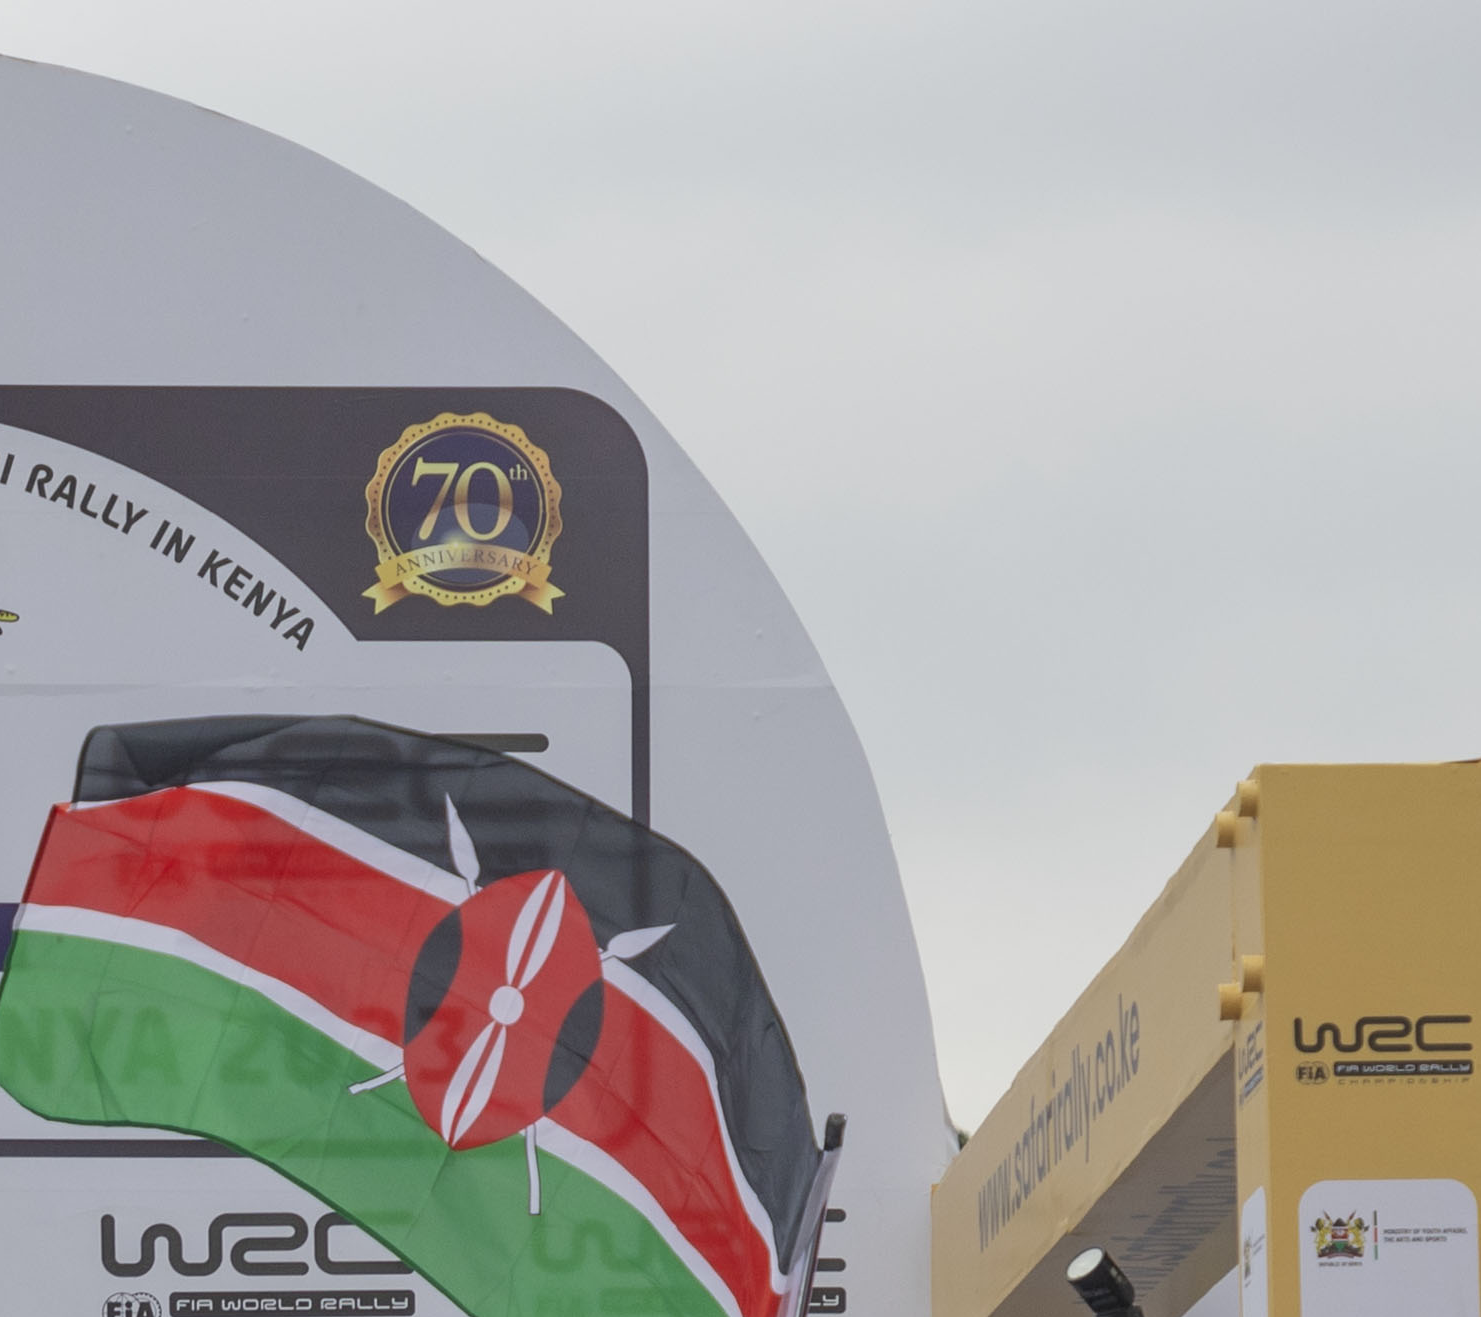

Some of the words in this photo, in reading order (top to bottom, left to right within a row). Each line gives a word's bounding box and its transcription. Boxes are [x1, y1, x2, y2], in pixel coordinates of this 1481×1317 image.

[24, 463, 149, 536] RALLY
[149, 518, 194, 565] IN
[197, 556, 317, 653] KENYA
[394, 549, 539, 578] ANNIVERSARY
[1294, 1014, 1474, 1054] WRC
[977, 994, 1142, 1254] www.safarirally.co.ke
[101, 1212, 415, 1277] WRC
[176, 1295, 215, 1312] FIA
[221, 1295, 315, 1312] WORLD
[320, 1295, 410, 1312] RALLY
